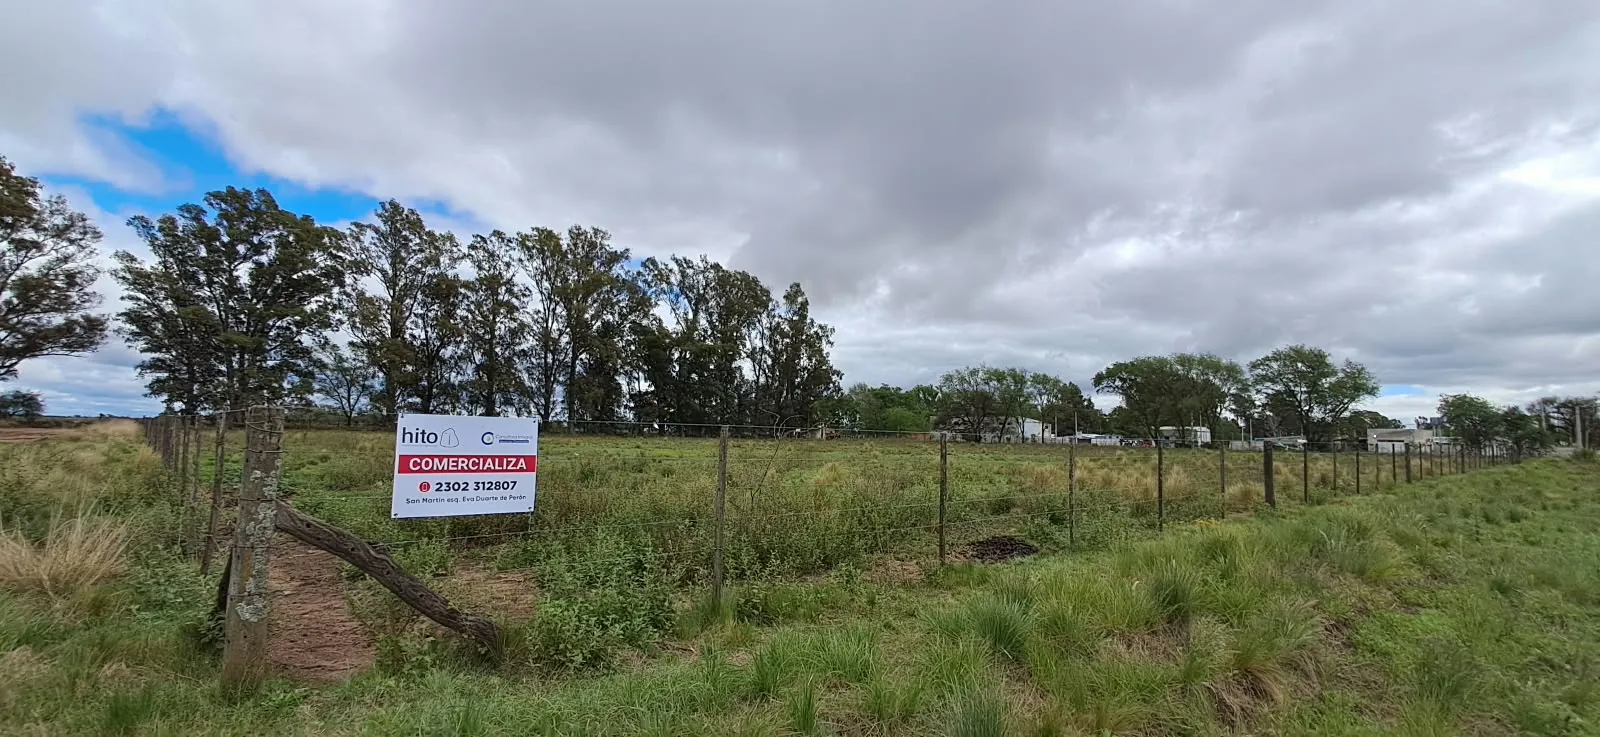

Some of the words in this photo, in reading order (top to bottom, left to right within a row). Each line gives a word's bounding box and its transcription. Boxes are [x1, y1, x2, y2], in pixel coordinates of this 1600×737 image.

[401, 426, 438, 444] hito
[409, 457, 527, 471] COMERCIALIZA
[434, 481, 469, 492] 2302
[473, 480, 518, 491] 312807
